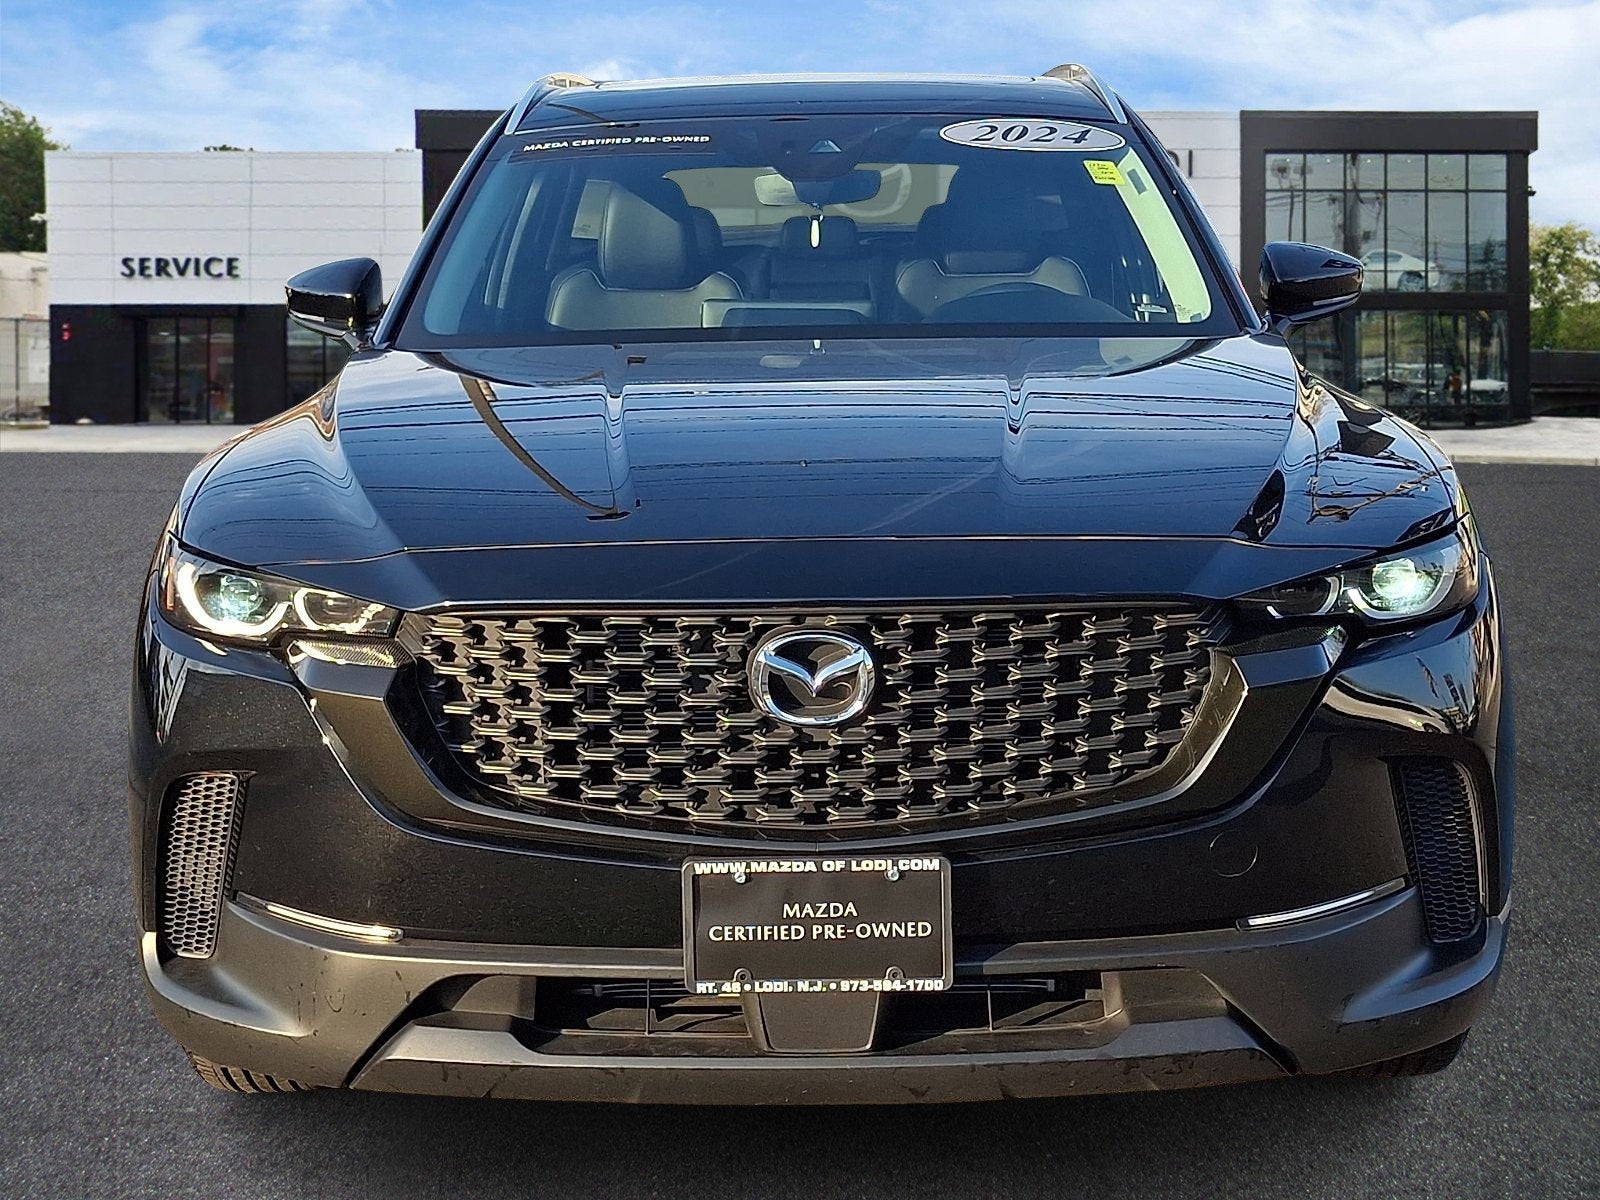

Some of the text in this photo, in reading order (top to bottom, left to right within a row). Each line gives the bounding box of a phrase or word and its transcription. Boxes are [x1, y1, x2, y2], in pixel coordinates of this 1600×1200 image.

[969, 124, 1094, 144] 2024
[523, 135, 710, 152] MAZDA CERTIFIED PRE-OWNED
[120, 257, 240, 278] SERVICE
[694, 859, 940, 874] WWW.MAZDA OF LODI.COM
[782, 902, 858, 919] MAZDA
[708, 921, 933, 941] CERTIFIED PRE-OWNED
[696, 982, 718, 993] RT.
[797, 980, 827, 992] N.J.
